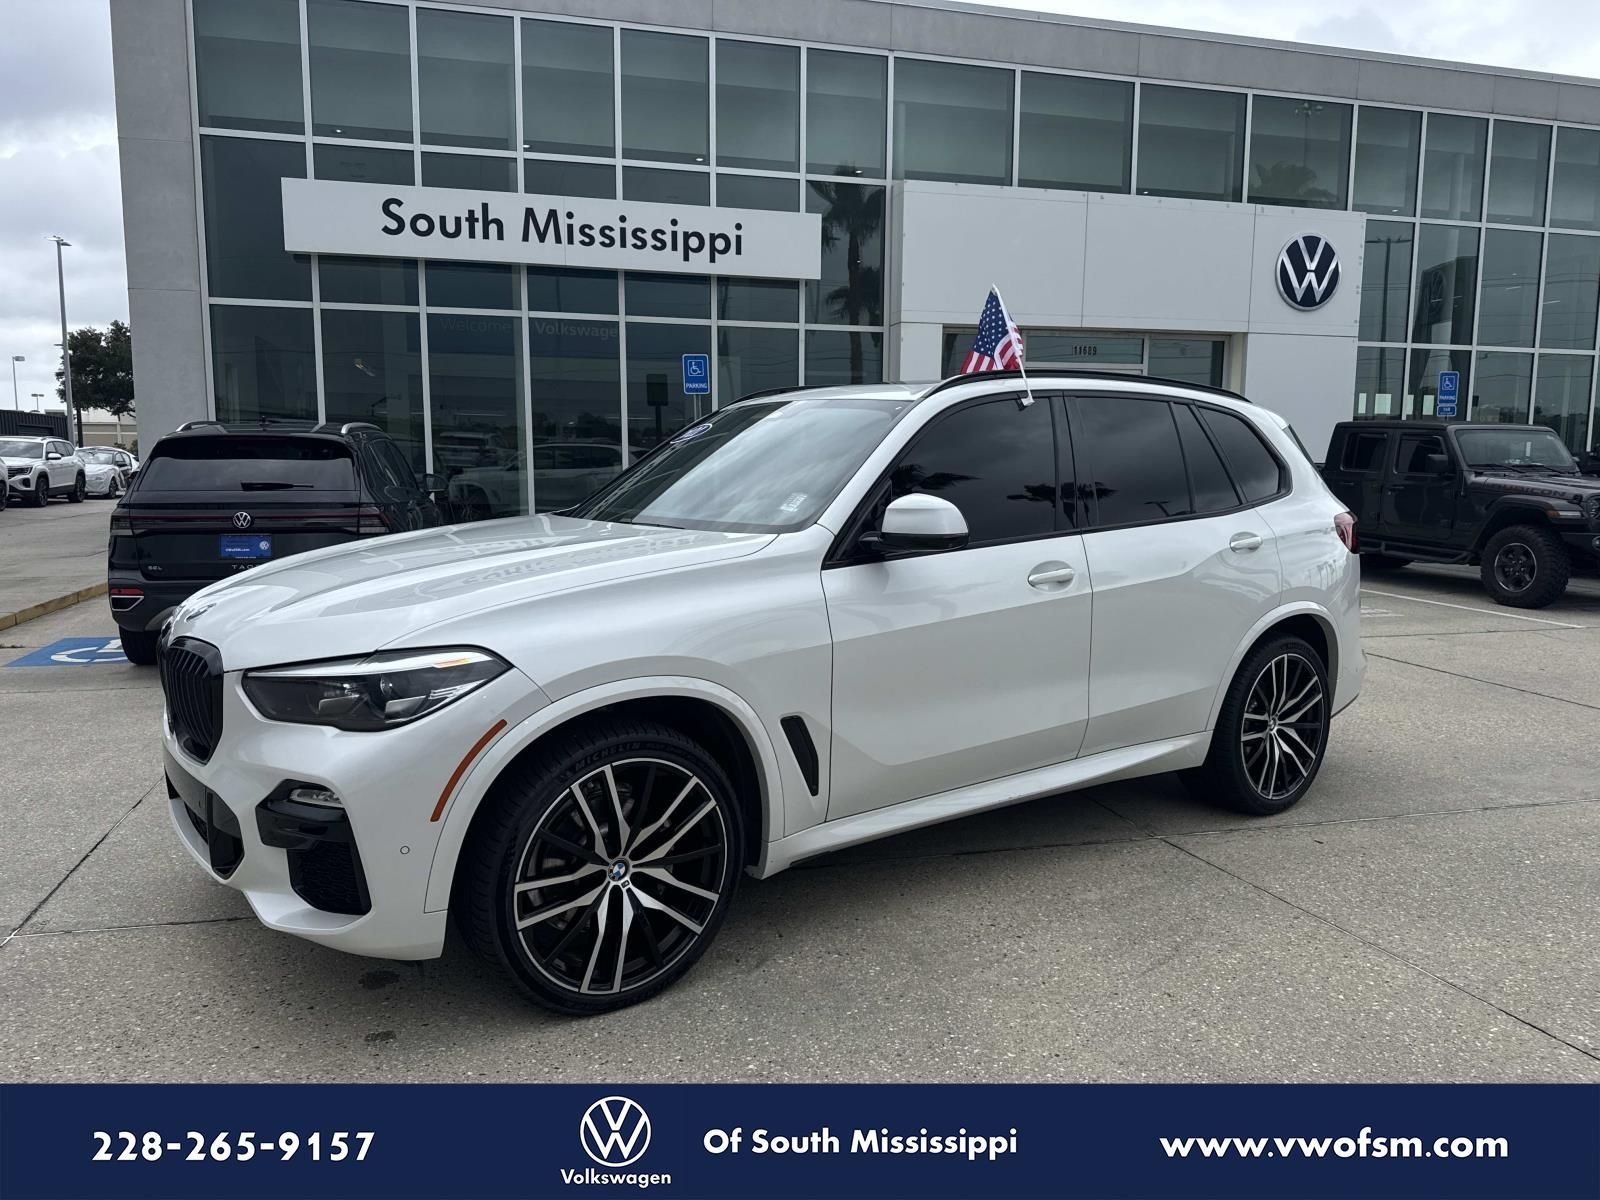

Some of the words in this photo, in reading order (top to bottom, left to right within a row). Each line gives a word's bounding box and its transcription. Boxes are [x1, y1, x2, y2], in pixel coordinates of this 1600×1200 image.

[381, 197, 504, 241] South
[521, 206, 743, 264] Mississippi
[534, 320, 619, 341] Volkswage
[574, 742, 642, 772] MICHELIN
